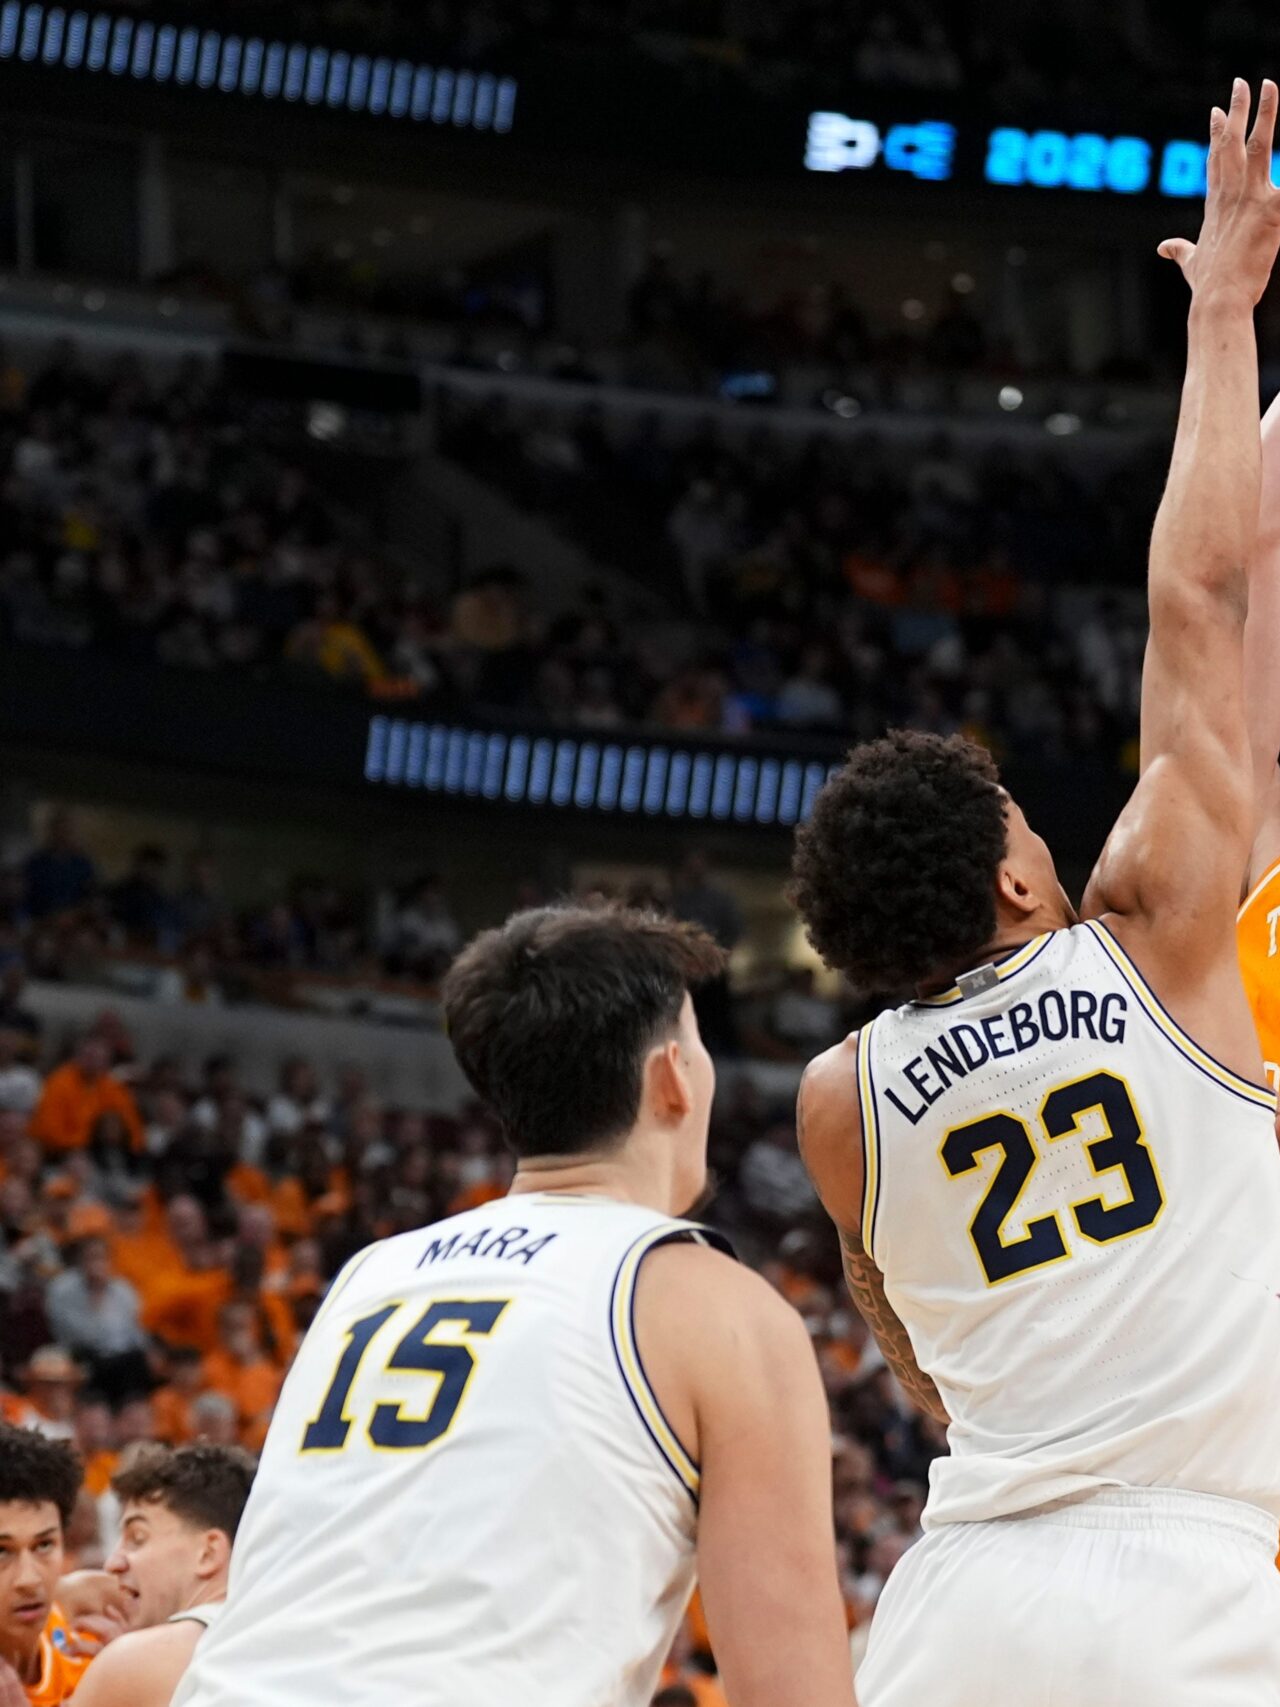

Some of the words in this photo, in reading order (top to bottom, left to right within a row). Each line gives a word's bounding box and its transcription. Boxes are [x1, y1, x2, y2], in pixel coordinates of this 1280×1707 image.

[985, 127, 1152, 194] 2026
[884, 989, 1128, 1126] LENDEBORG
[937, 1067, 1167, 1289] 23
[415, 1226, 559, 1270] MARA
[298, 1297, 515, 1455] 15
